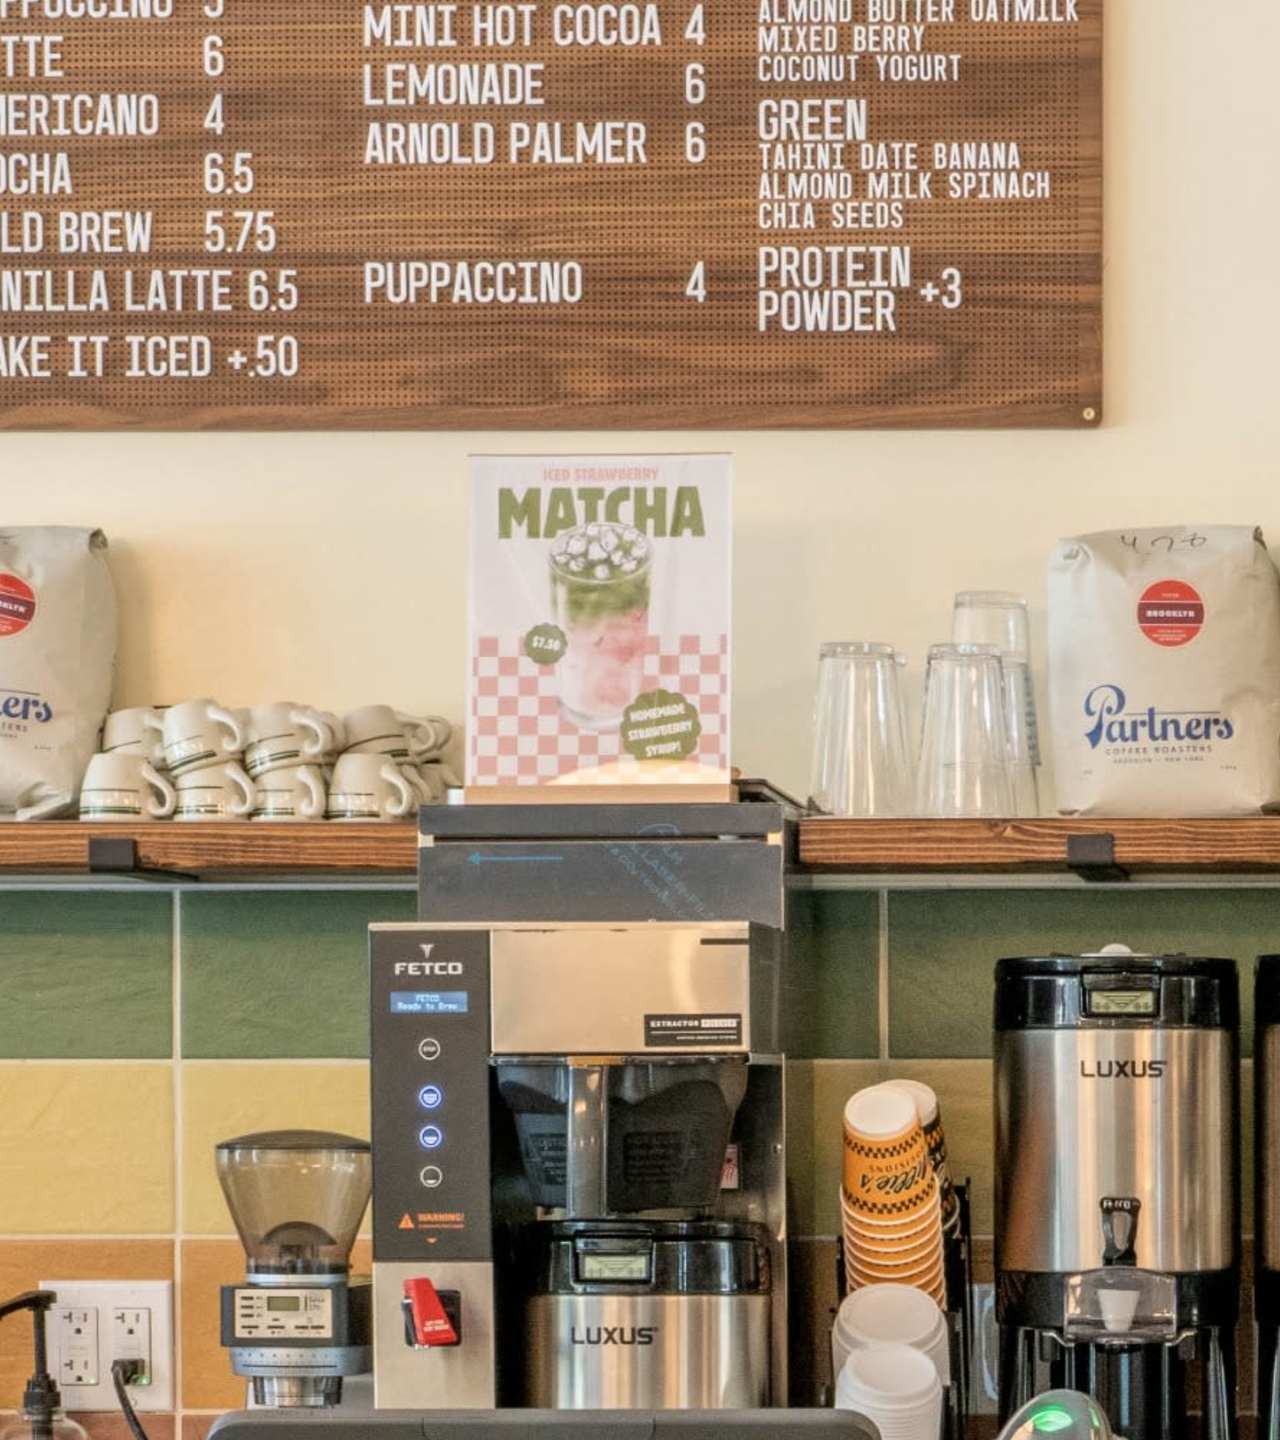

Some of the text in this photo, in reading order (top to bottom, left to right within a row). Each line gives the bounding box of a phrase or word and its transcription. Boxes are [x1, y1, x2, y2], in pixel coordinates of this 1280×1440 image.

[203, 93, 225, 135] 4
[758, 201, 903, 229] CHIA SEEDS
[59, 210, 153, 254] BREW
[204, 209, 276, 253] 5.75
[364, 261, 706, 304] PUPPACCINO 4
[67, 335, 109, 377] IT
[125, 335, 211, 377] ICED
[544, 467, 658, 481] ICED STRAWBERRY
[498, 486, 705, 539] MATCHA
[1145, 610, 1195, 618] BROOKLYN
[1084, 684, 1234, 750] Partners
[628, 720, 692, 741] STRAWBERRY
[1105, 744, 1213, 756] COFFEE ROASTERS
[394, 962, 463, 975] FETCO
[1080, 1060, 1163, 1078] LUXUS
[571, 1326, 654, 1345] LUXUS
